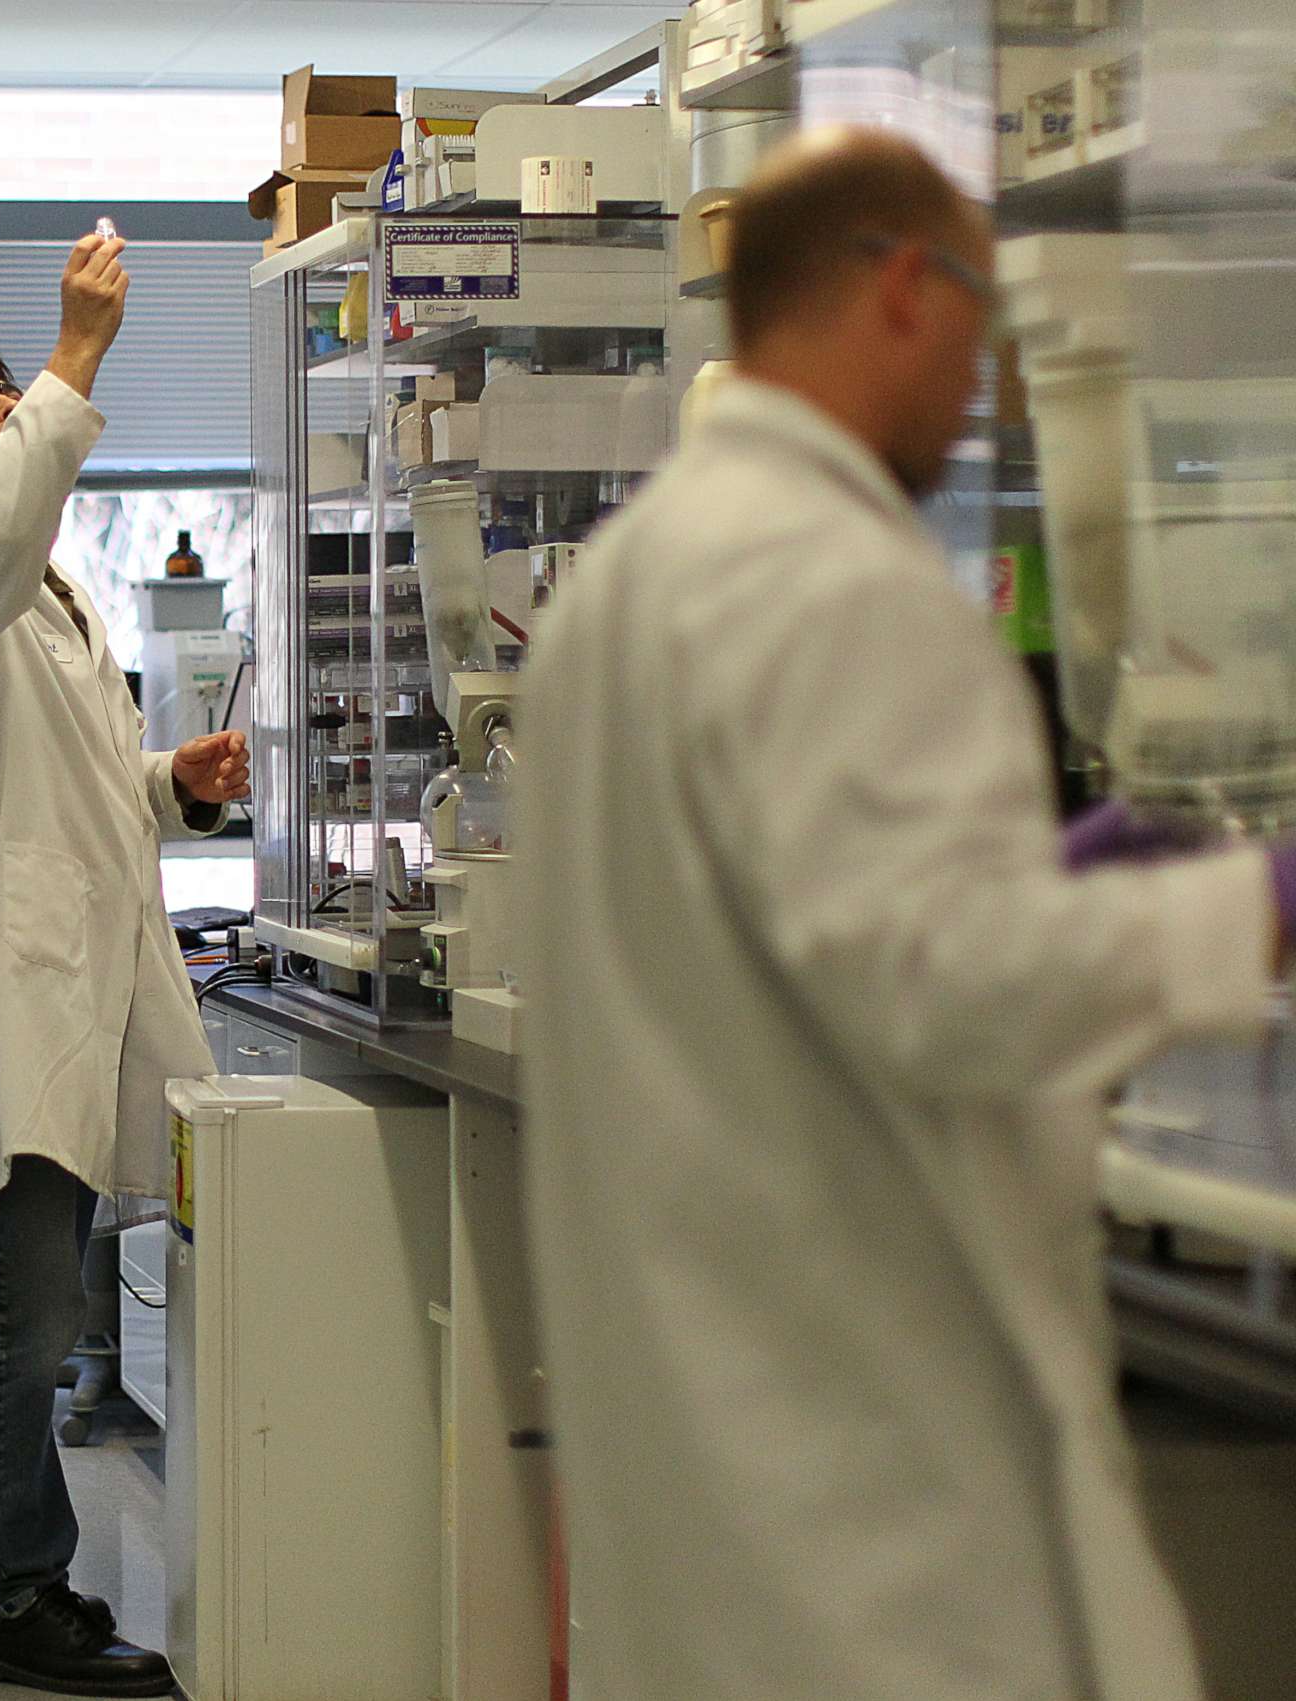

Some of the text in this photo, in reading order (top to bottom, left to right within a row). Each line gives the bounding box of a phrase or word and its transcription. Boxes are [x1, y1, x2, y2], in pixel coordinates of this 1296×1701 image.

[390, 231, 513, 244] Certificate of Compliance
